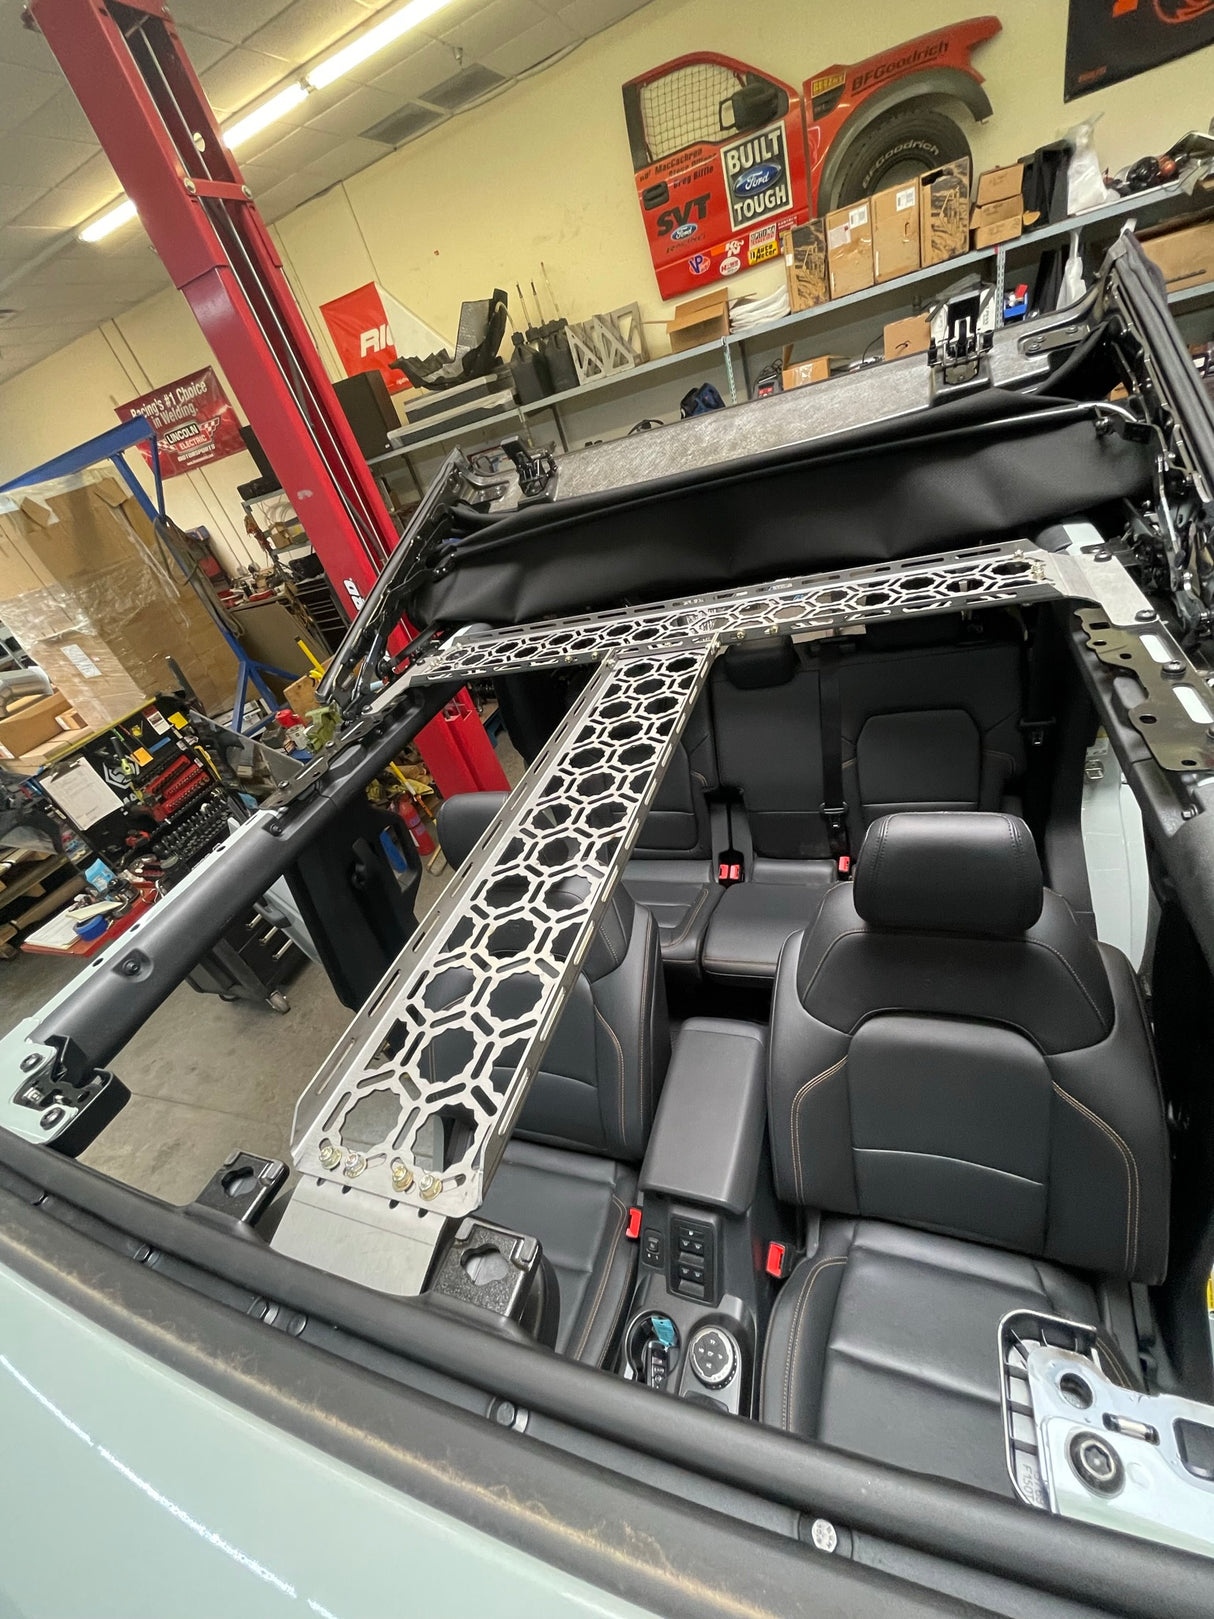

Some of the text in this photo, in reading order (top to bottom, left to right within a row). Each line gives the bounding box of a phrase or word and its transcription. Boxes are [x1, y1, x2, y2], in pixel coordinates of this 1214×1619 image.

[851, 42, 950, 92] BFGoodrich
[726, 129, 781, 176] BUILT
[744, 170, 770, 191] Ford
[657, 191, 711, 237] SVT
[733, 184, 787, 222] TOUGH
[689, 254, 704, 274] VP
[130, 380, 208, 419] Racing's #1 Choice
[151, 415, 162, 429] in
[166, 424, 199, 445] LINCOLN
[179, 434, 208, 450] ELECTRIC
